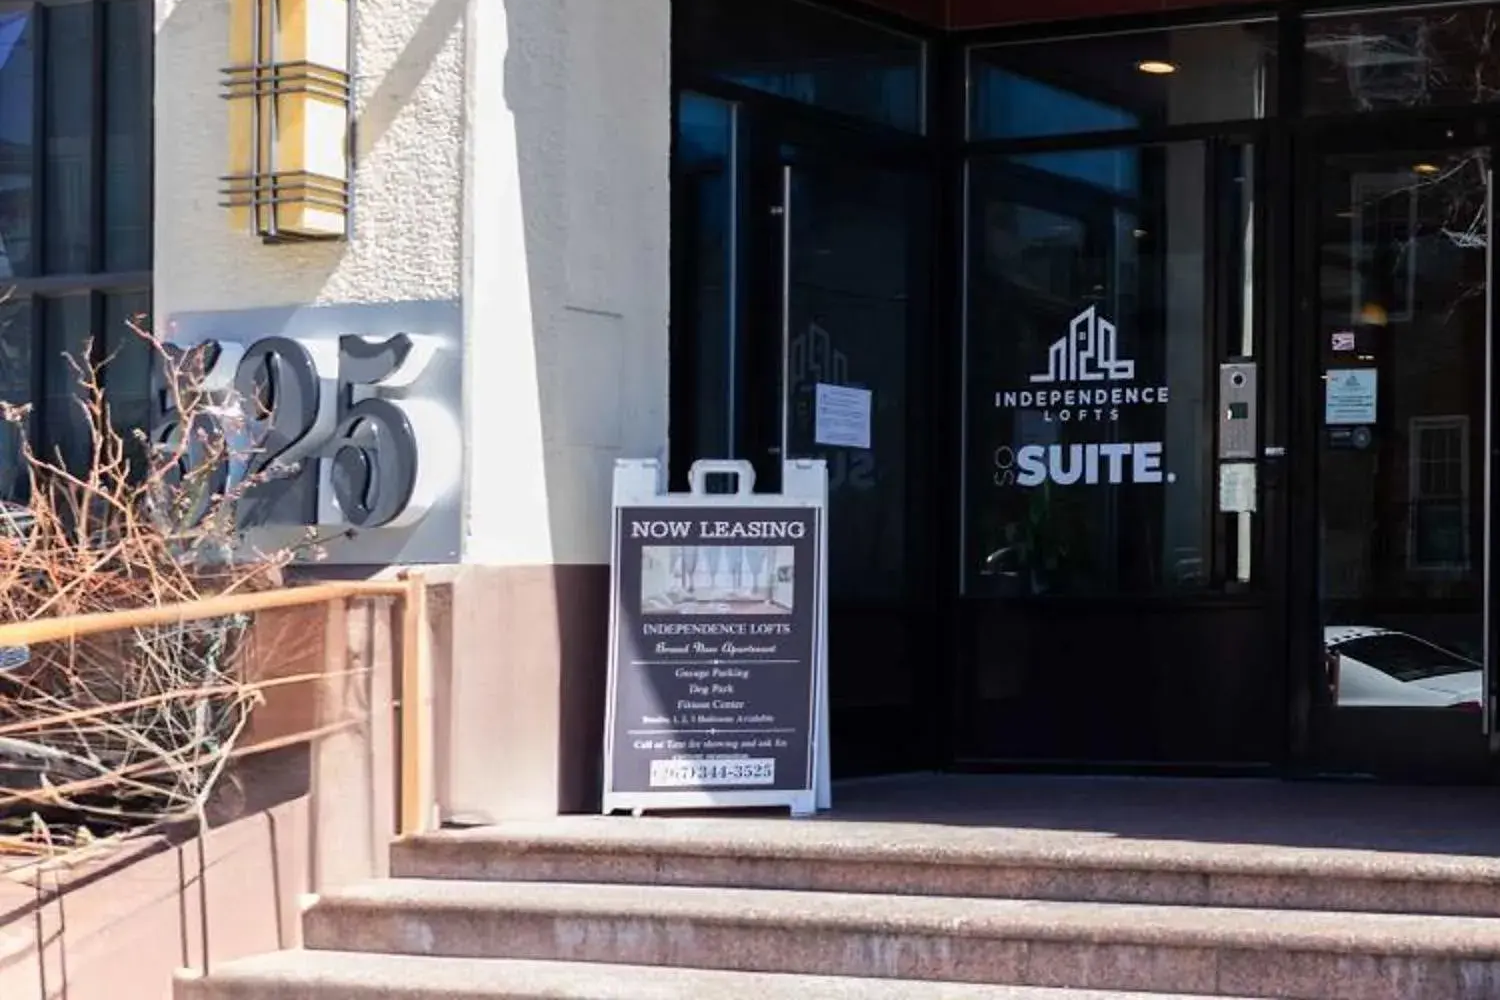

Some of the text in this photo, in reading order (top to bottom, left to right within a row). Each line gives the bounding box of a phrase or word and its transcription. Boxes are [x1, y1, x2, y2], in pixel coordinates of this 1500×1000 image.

[995, 387, 1169, 408] INDEPENDENCE
[1043, 409, 1120, 422] LOFTS
[631, 521, 805, 539] NOW LEASING
[643, 623, 791, 636] INDEPENDENCE LOFTS
